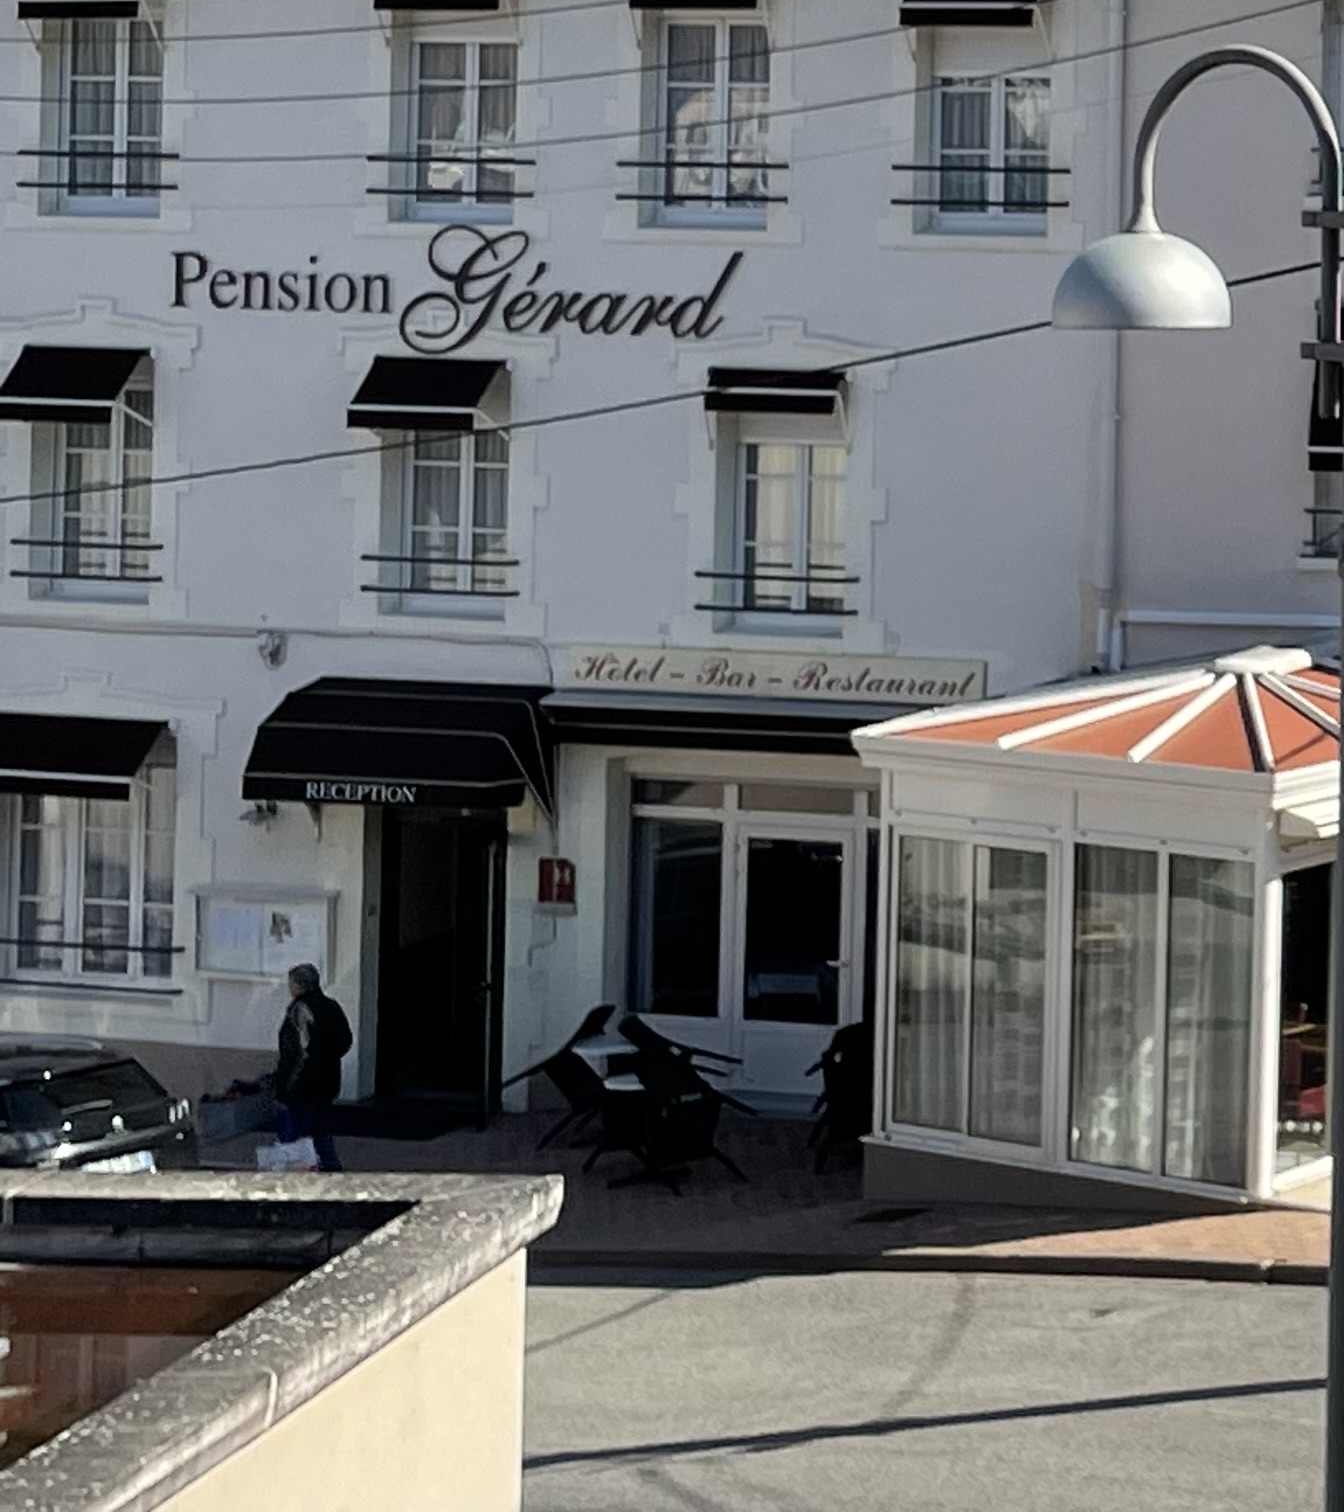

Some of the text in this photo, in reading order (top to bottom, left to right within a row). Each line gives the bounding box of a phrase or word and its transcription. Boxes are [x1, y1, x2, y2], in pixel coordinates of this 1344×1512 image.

[171, 224, 744, 354] Pension Gérard
[575, 651, 666, 682] Hôtel
[696, 657, 756, 688] Bar
[793, 661, 976, 697] Restaurant
[306, 782, 417, 803] RECEPTION
